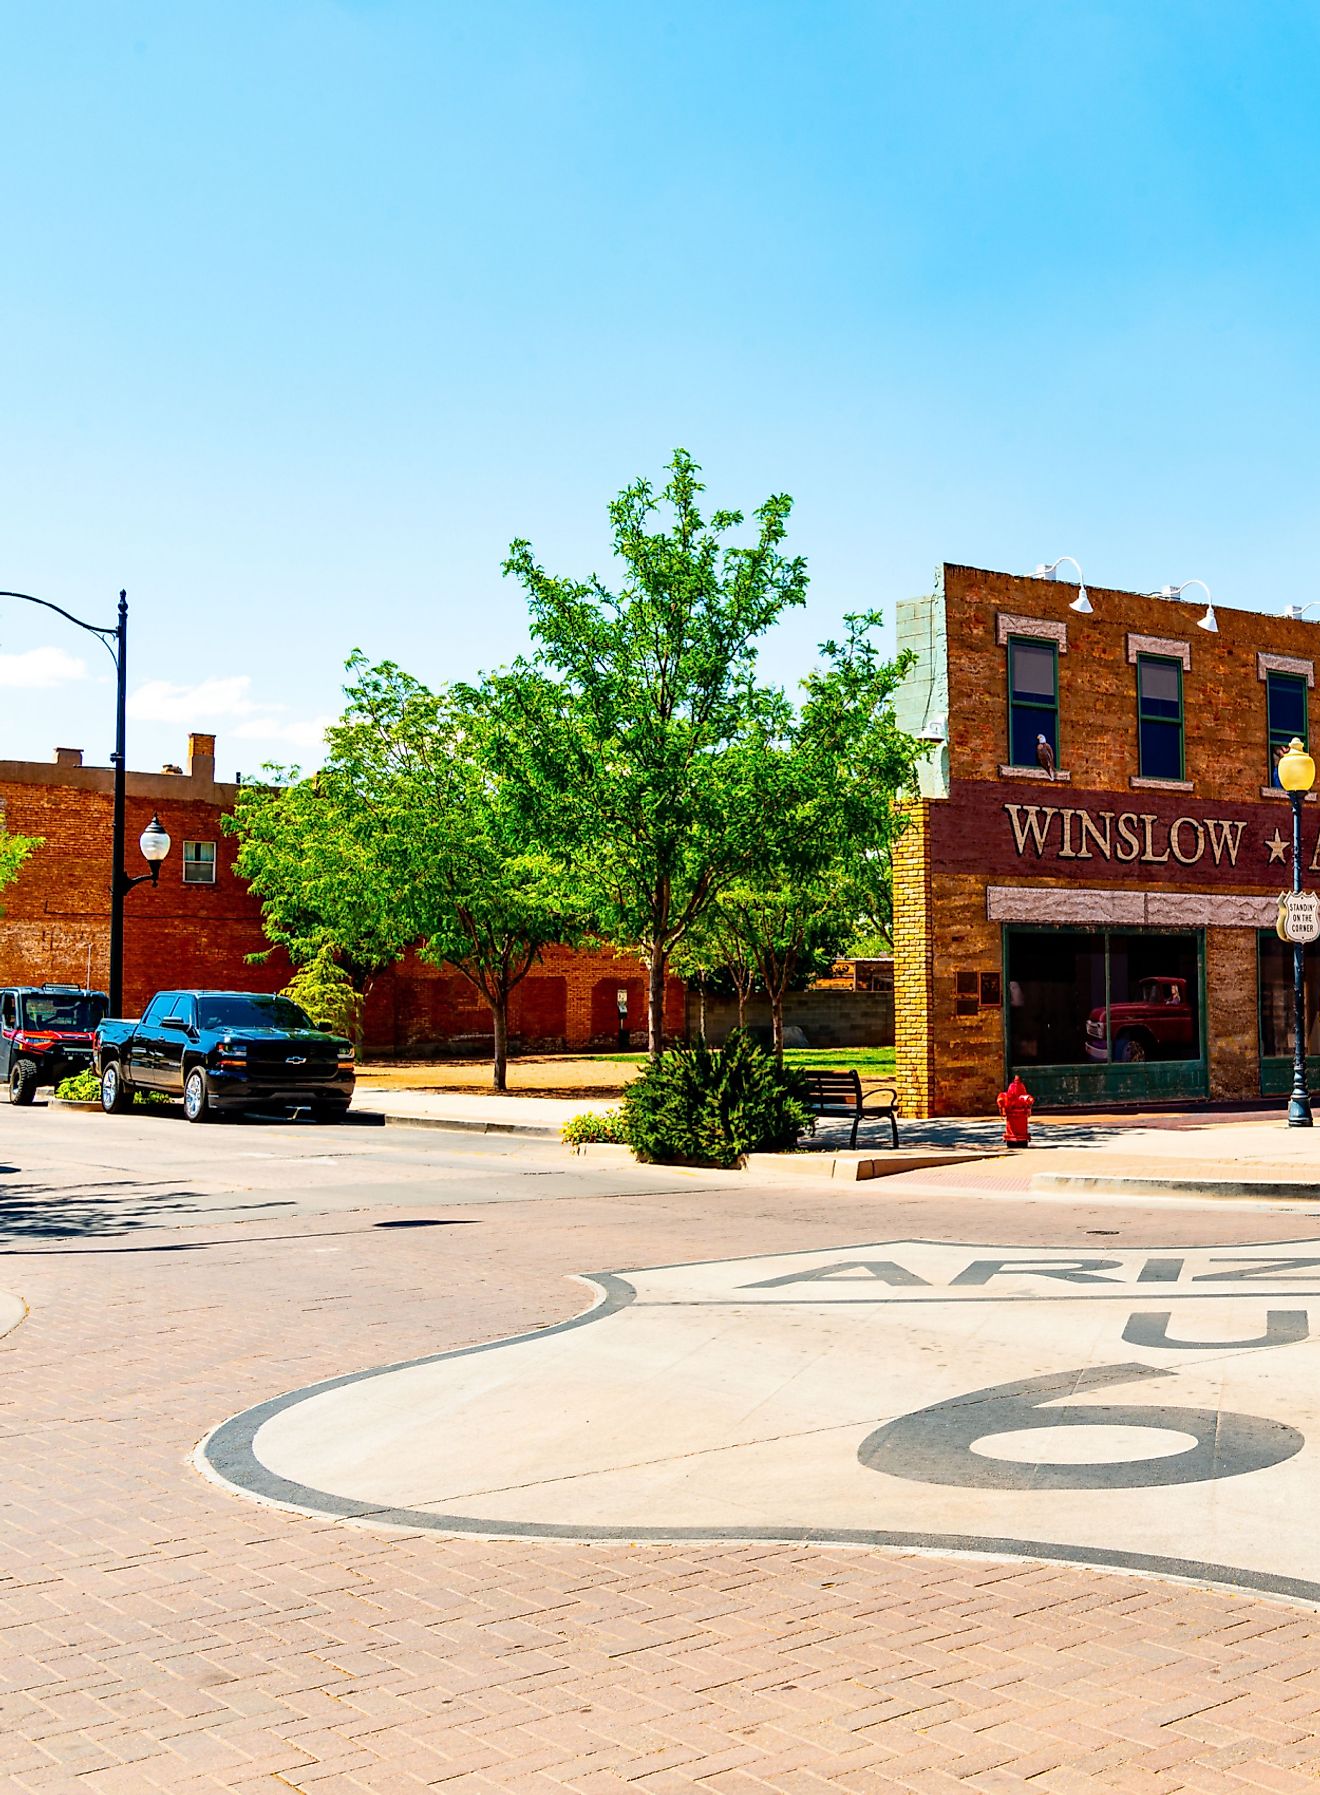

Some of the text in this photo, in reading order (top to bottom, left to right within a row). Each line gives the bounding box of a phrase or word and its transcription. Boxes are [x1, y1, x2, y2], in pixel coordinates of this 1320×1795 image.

[1004, 803, 1247, 867] WINSLOW
[1290, 903, 1315, 911] STANDIN'
[1293, 914, 1312, 922] ON THE
[1292, 924, 1313, 932] CORNER
